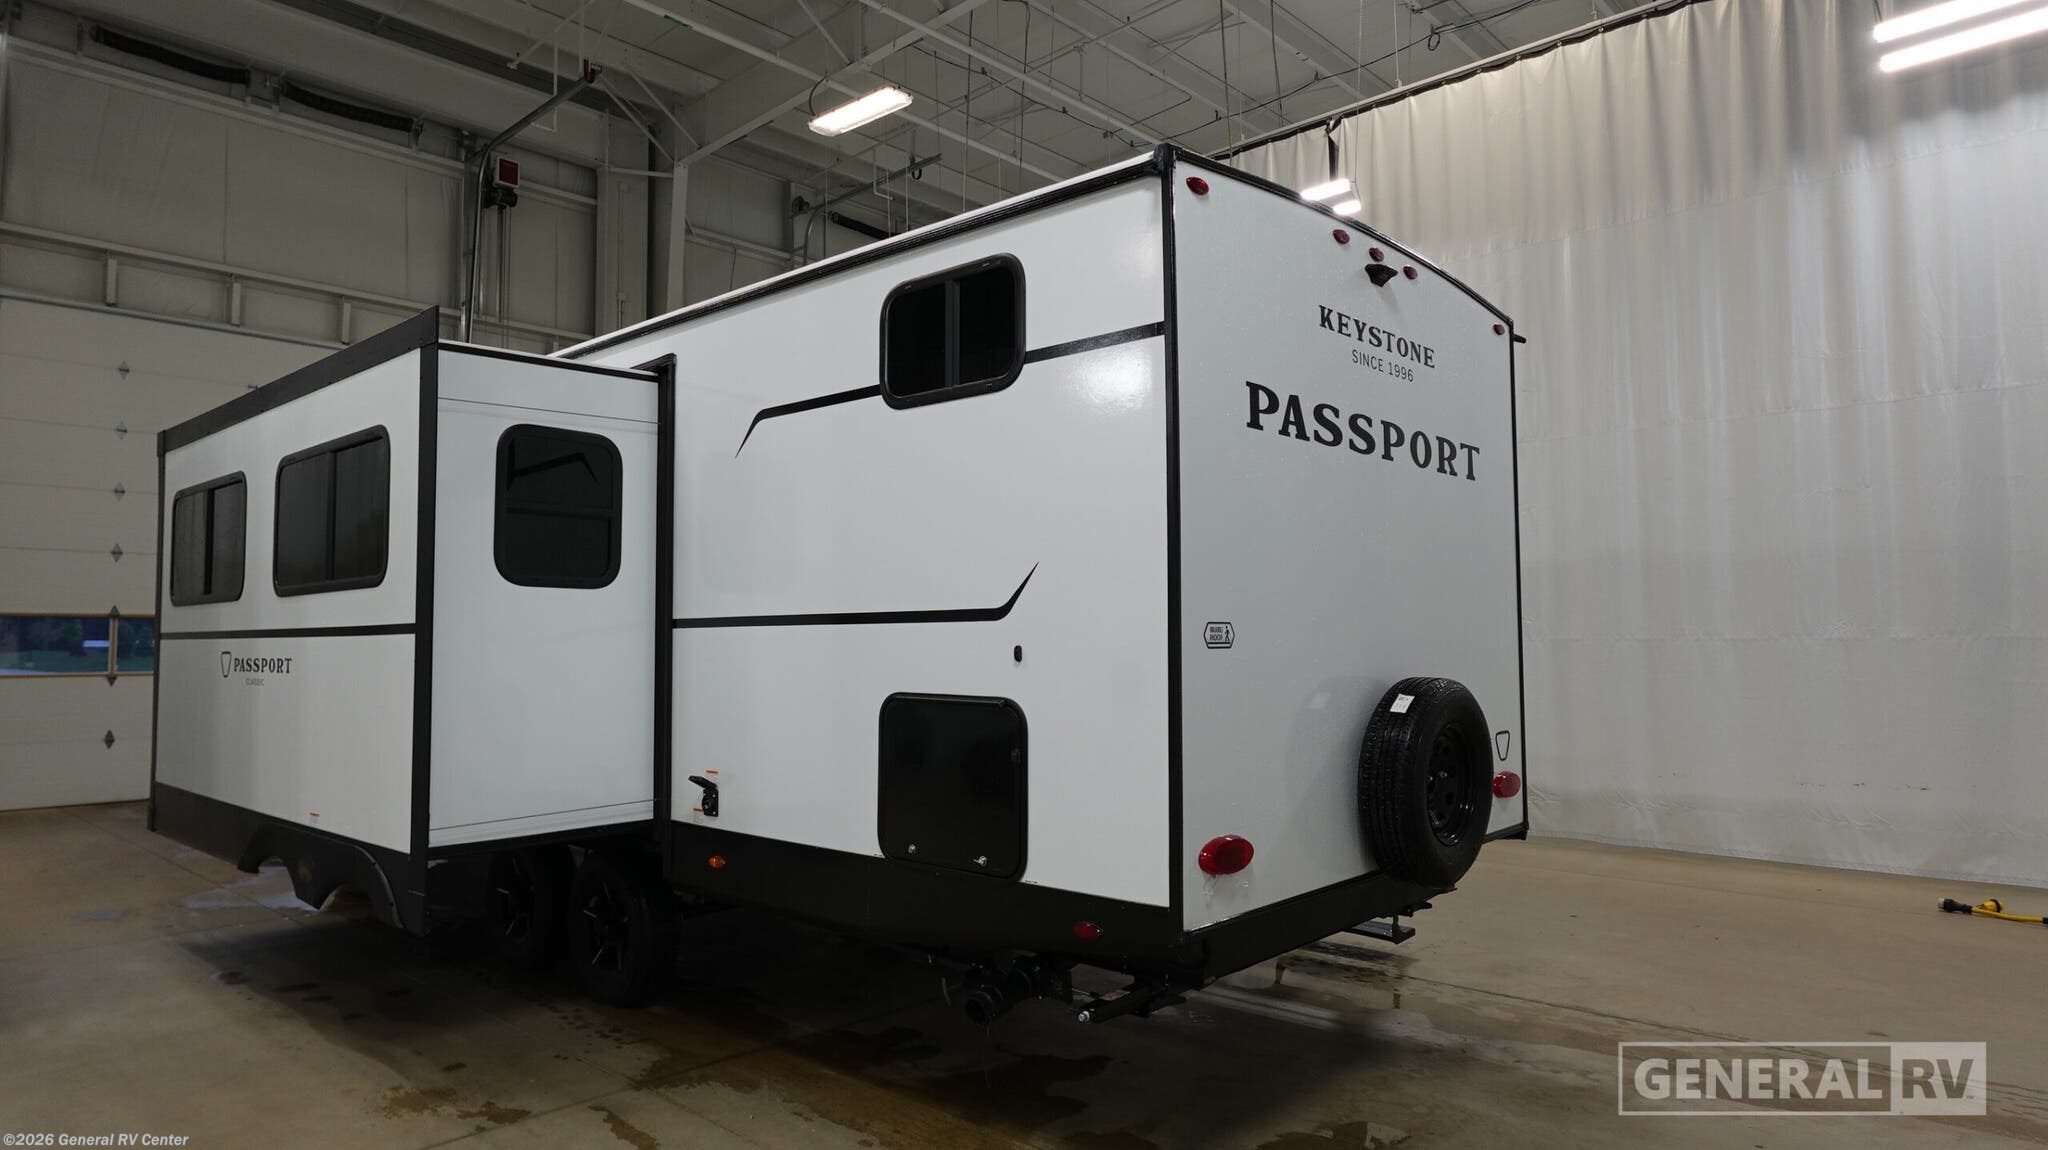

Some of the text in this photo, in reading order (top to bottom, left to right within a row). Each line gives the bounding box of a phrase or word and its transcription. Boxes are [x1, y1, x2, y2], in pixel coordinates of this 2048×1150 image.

[1319, 305, 1435, 368] KEYSTONE
[1352, 349, 1414, 382] SINCE 1996
[1246, 381, 1480, 481] PASSPORT
[233, 658, 292, 674] PASSPORT
